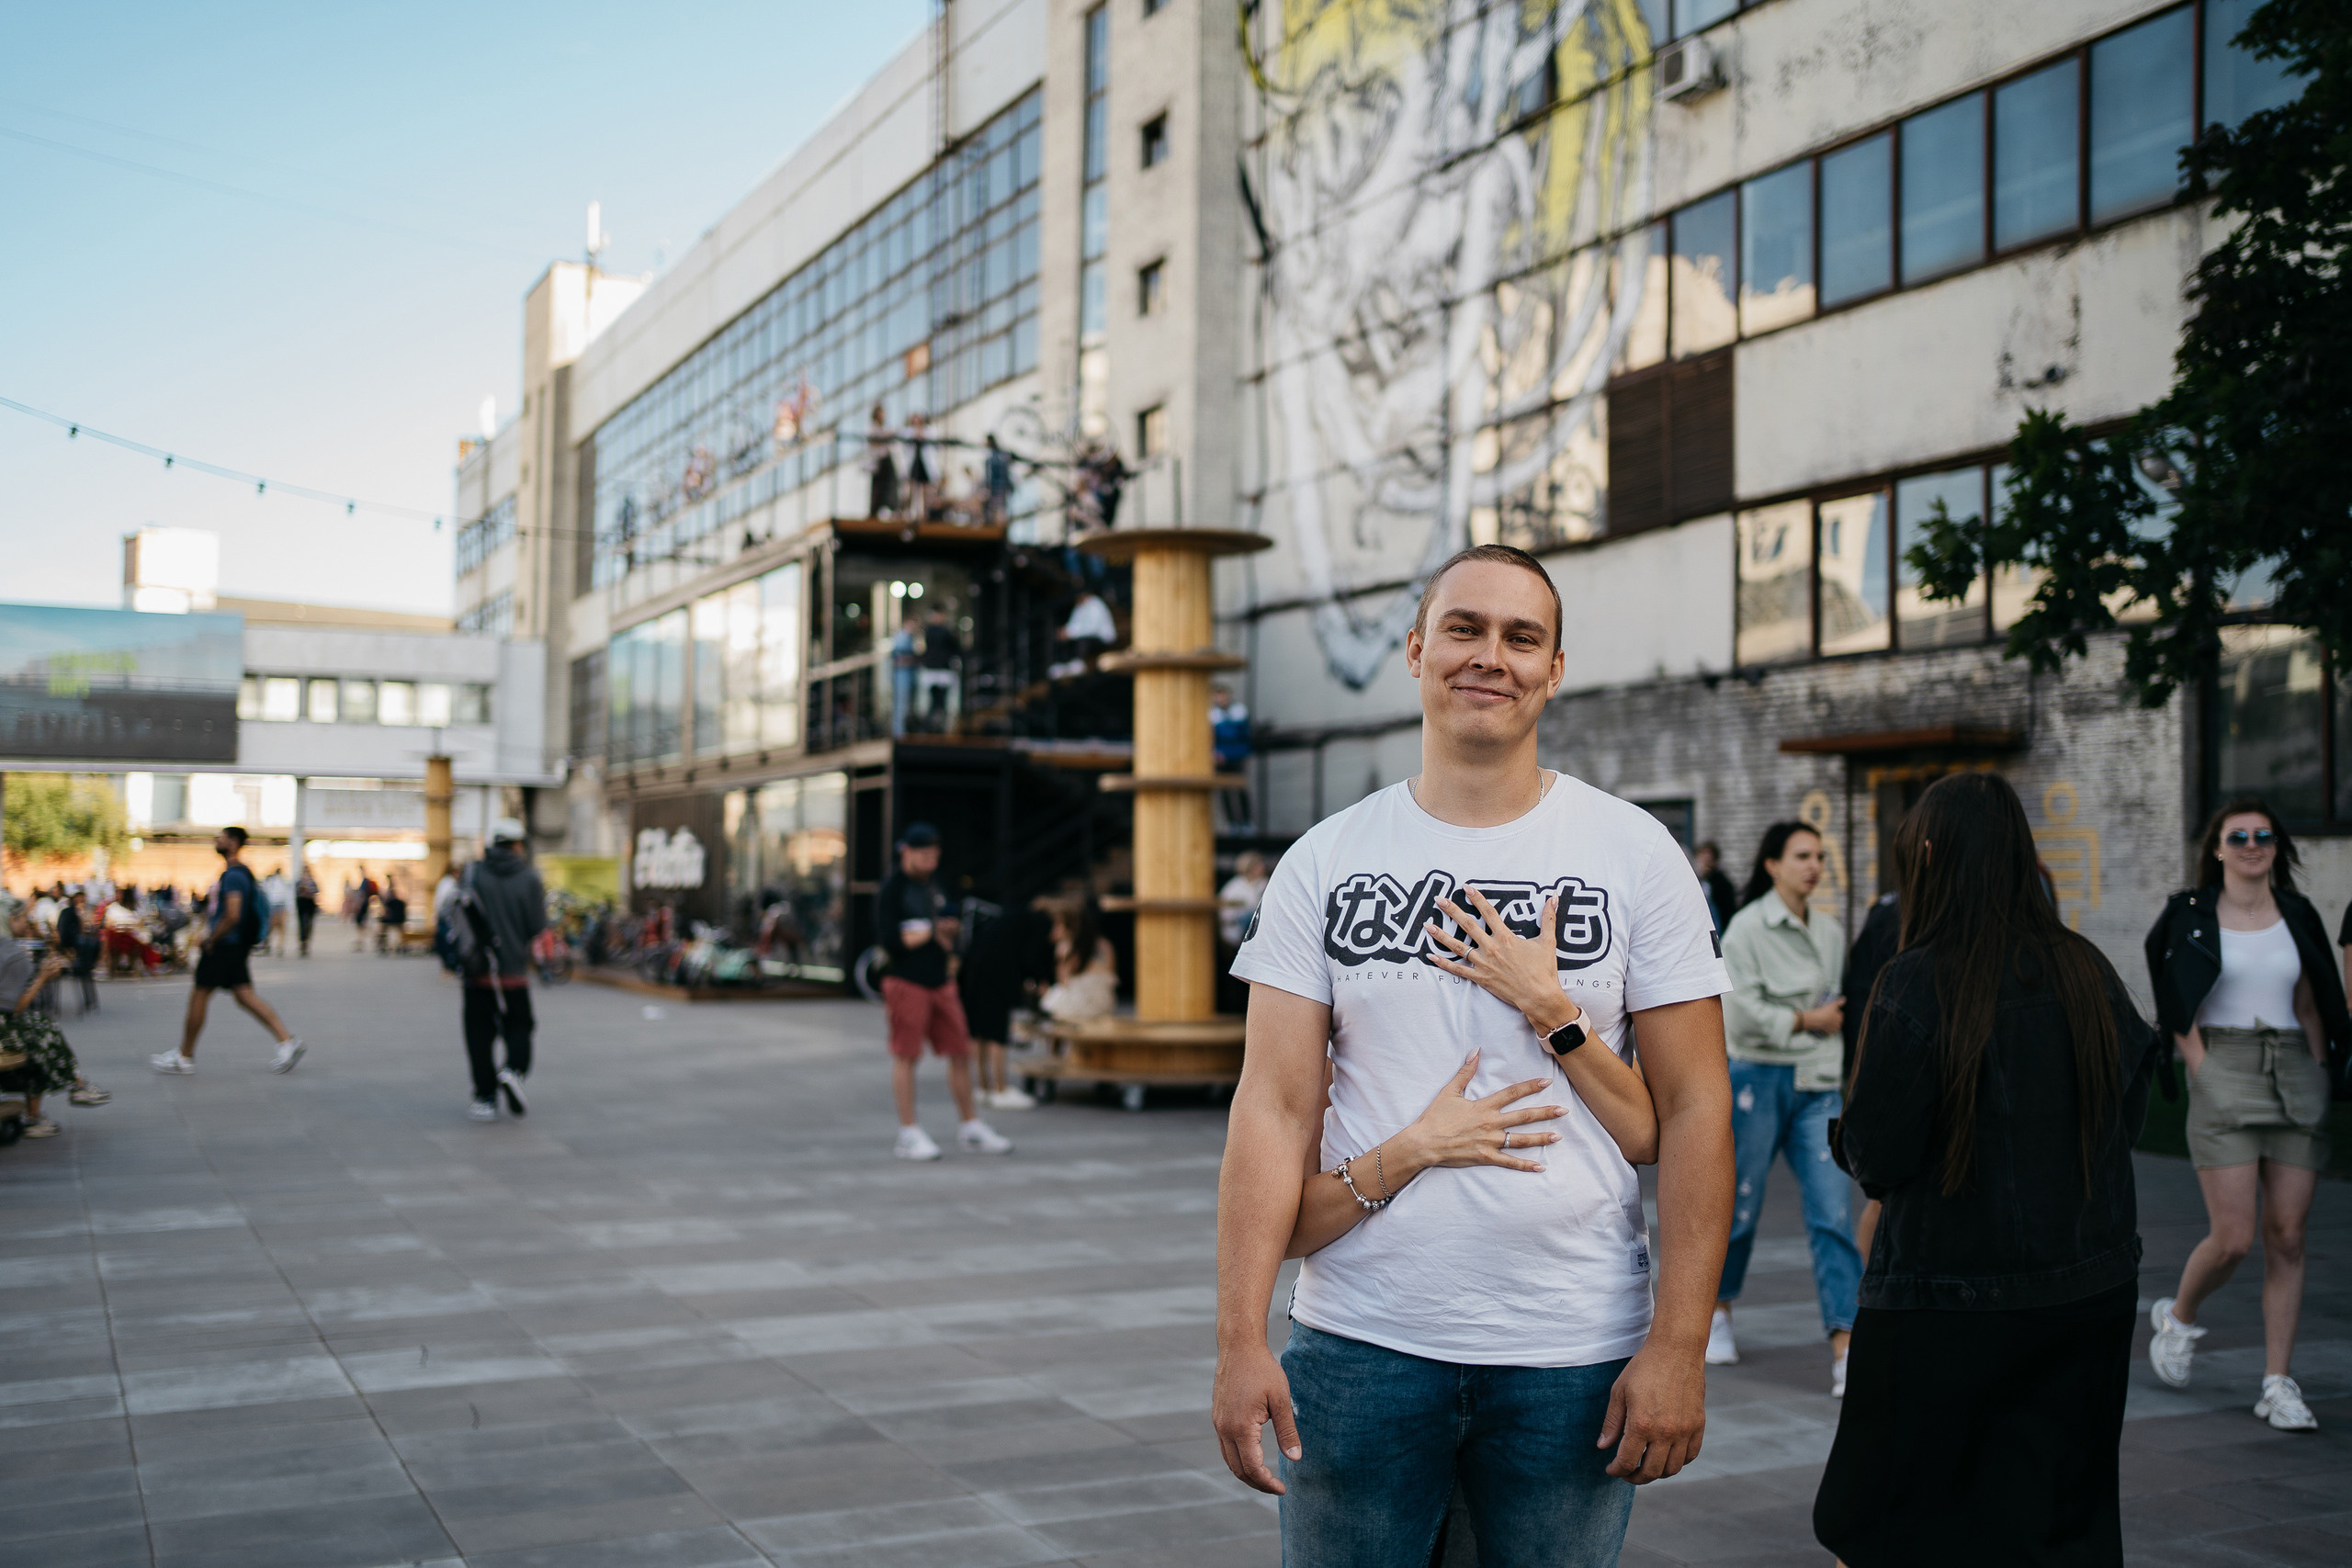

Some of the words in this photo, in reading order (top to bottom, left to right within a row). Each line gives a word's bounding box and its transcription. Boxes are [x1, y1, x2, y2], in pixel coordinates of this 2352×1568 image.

[1332, 971, 1419, 983] HATEVER
[1438, 975, 1470, 985] FU
[1564, 977, 1611, 988] INGS
